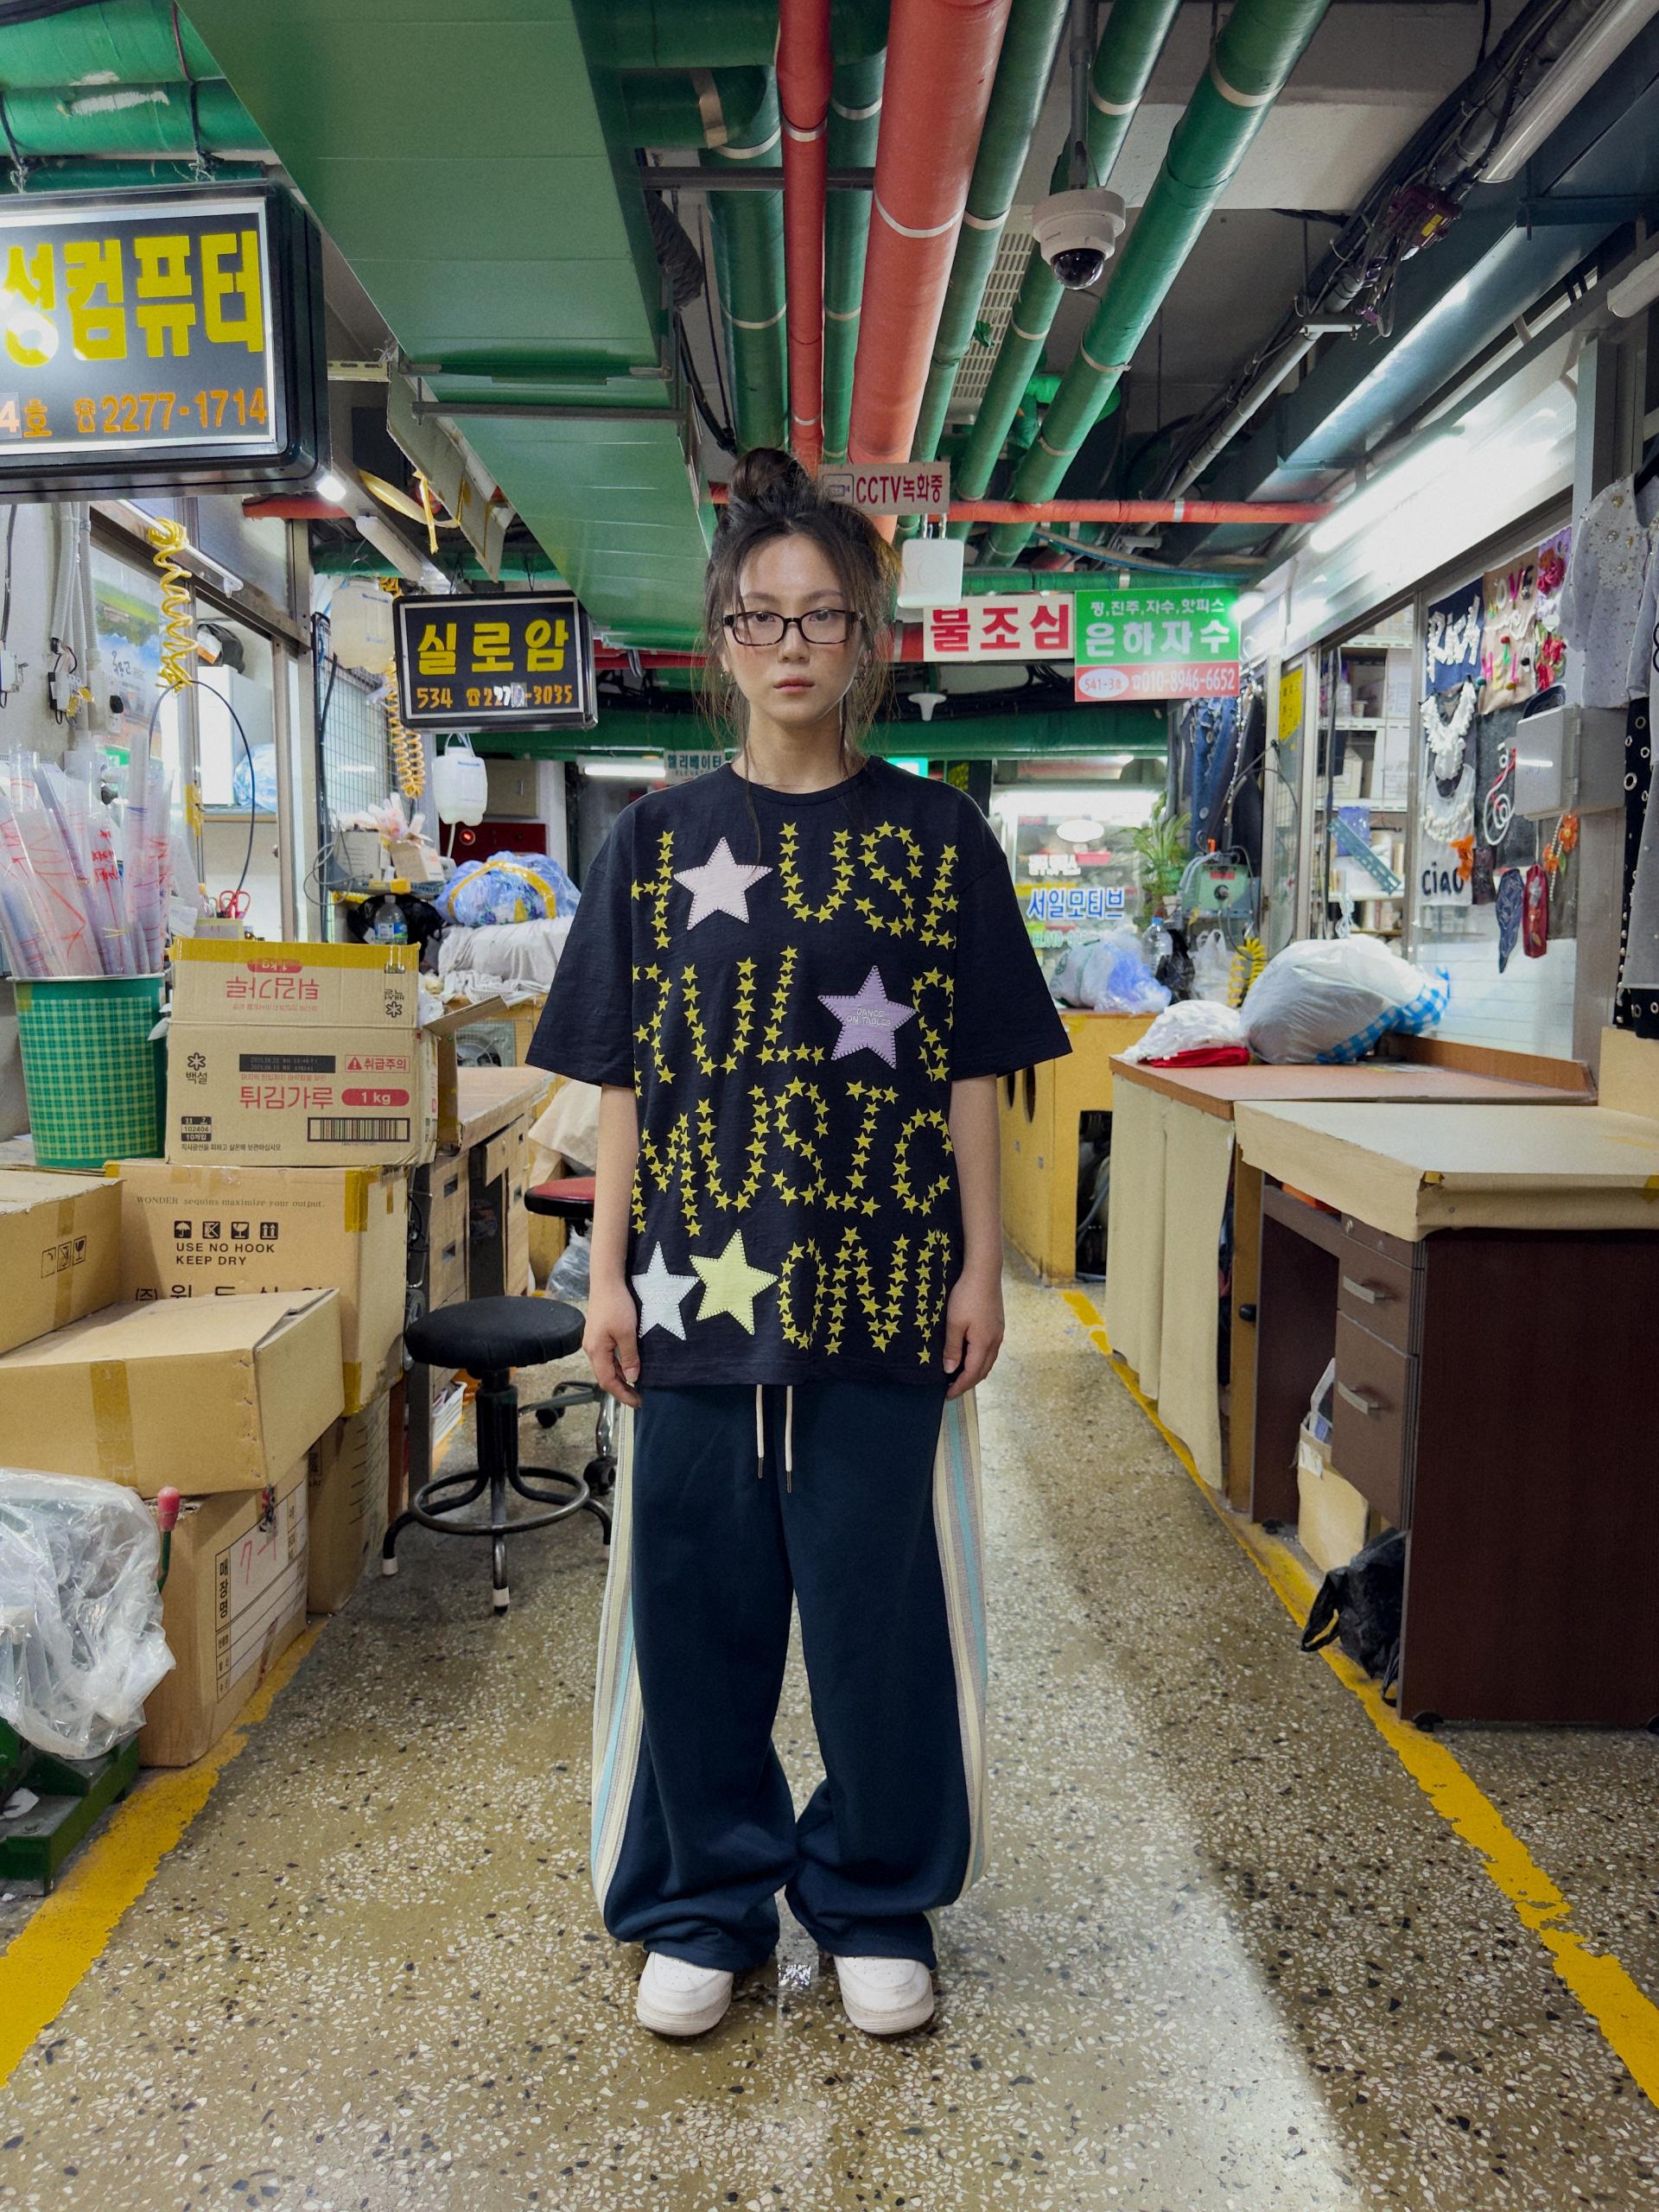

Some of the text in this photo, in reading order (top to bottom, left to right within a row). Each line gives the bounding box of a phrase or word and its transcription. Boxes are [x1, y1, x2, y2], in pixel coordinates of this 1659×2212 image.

[3, 231, 264, 367] 성컴퓨터
[102, 388, 268, 433] 2277-1714
[855, 474, 943, 504] CCTV녹화중
[930, 604, 1070, 653] 불조심
[1085, 620, 1230, 658] 은하자수
[417, 619, 569, 676] 실로암
[416, 686, 453, 709] 534
[667, 754, 721, 770] 엘리베이터
[1027, 887, 1124, 920] 서일모티브
[226, 976, 320, 1001] 튀김가루
[847, 1015, 892, 1027] ON TABLES
[857, 1007, 884, 1018] DANCE
[364, 1057, 407, 1071] 취급주의
[186, 1071, 208, 1084] 백설
[240, 1085, 334, 1109] 튀김가루
[373, 1091, 391, 1105] kg
[137, 1196, 179, 1205] WONDER
[183, 1198, 219, 1206] sequins
[176, 1243, 276, 1253] USE NO HOOK
[176, 1255, 247, 1266] KEEP DRY
